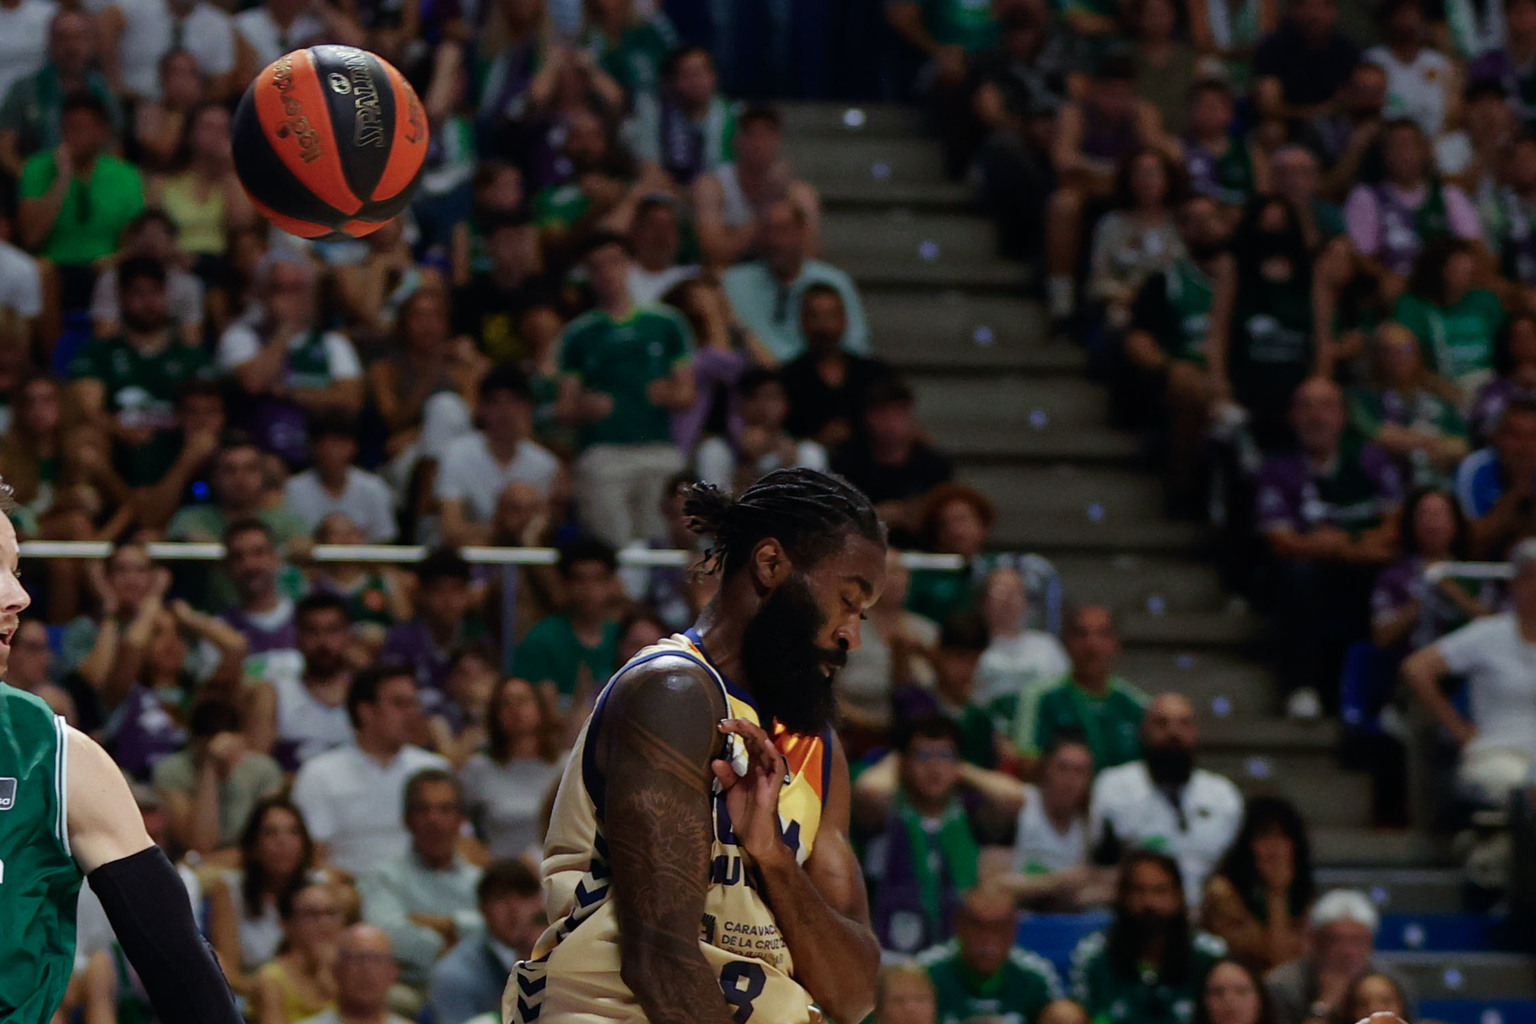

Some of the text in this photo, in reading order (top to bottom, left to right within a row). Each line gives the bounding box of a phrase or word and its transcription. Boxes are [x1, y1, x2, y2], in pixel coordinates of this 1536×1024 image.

[724, 921, 777, 937] CARAVAC
[721, 934, 737, 946] DE
[739, 937, 752, 948] LA
